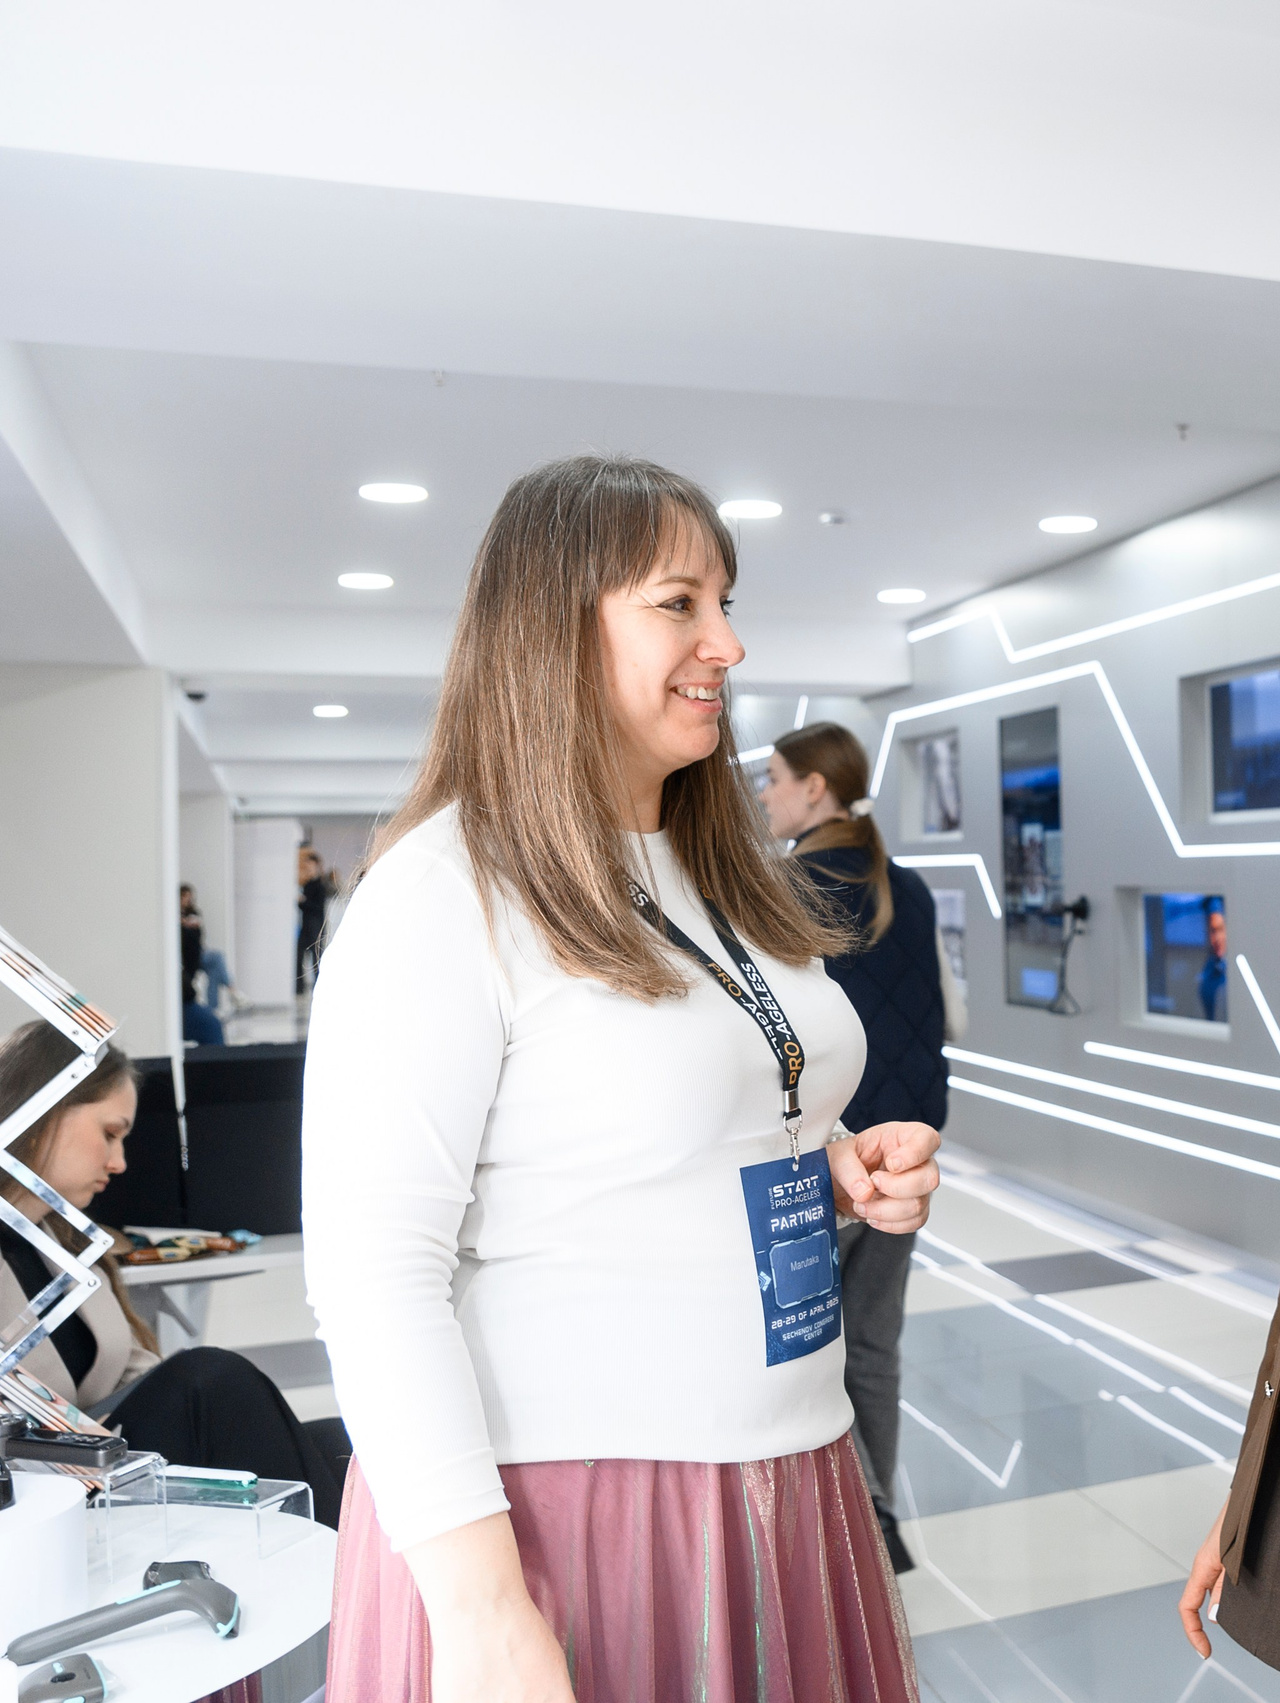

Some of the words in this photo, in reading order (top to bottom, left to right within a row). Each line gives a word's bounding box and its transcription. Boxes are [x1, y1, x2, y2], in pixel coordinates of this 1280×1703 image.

[740, 962, 803, 1086] PRO-AGELESS
[772, 1175, 819, 1198] START
[775, 1189, 821, 1209] PRO-AGELESS
[770, 1205, 825, 1233] PARTNER
[771, 1315, 796, 1330] 28-29
[798, 1310, 808, 1321] OF
[809, 1304, 826, 1317] APRIL
[803, 1328, 824, 1342] CENTER
